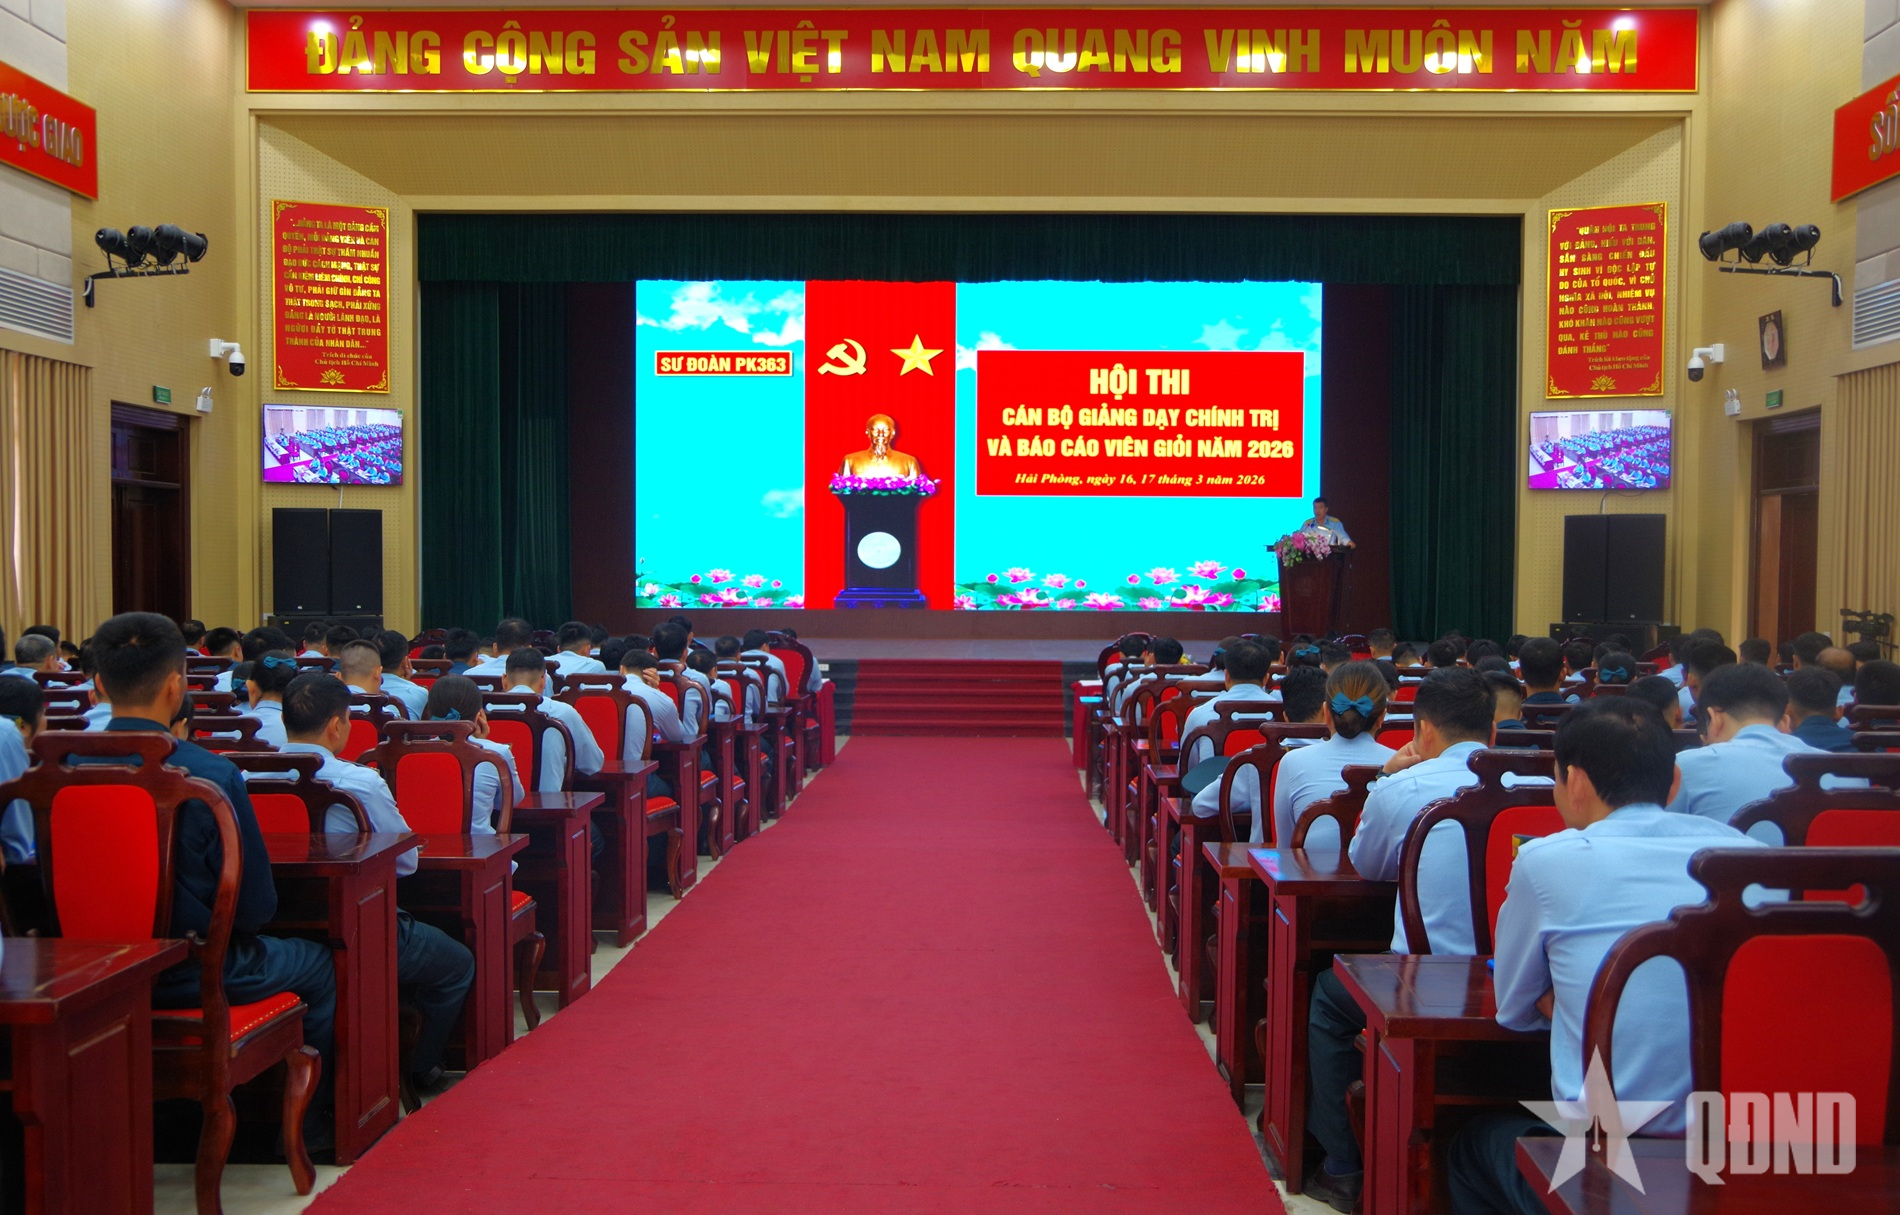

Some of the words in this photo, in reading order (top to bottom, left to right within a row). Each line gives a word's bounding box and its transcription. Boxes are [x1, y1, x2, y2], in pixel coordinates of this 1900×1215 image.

[305, 15, 441, 76] ĐẢNG
[463, 21, 596, 84] CỘNG
[618, 15, 722, 76] SẢN
[746, 21, 848, 83] VIỆT
[871, 29, 990, 74] NAM
[1012, 28, 1182, 79] QUANG
[1203, 29, 1321, 74] VINH
[1344, 19, 1492, 74] MUÔN
[1516, 19, 1638, 74] NĂM
[0, 92, 39, 152] ƯỢC
[43, 113, 83, 168] GIAO
[661, 356, 684, 372] SƯ
[686, 355, 730, 372] ĐOÀN
[736, 357, 786, 372] PK363
[1090, 363, 1137, 400] HỘI
[1146, 369, 1189, 395] THI
[1002, 405, 1042, 426] CÁN
[1048, 405, 1073, 429] BỘ
[1078, 403, 1137, 426] GIẢNG
[1143, 408, 1180, 430] DẠY
[1185, 406, 1243, 427] CHÍNH
[1250, 409, 1279, 431] TRỊ
[987, 436, 1012, 456] VÀ
[1017, 436, 1055, 456] BÁO
[1061, 436, 1099, 456] CÁO
[1105, 436, 1148, 457] VIÊN
[1153, 434, 1191, 457] GIỎI
[1197, 436, 1242, 458] NĂM
[1247, 440, 1294, 458] 2026
[1015, 473, 1038, 484] Hải
[1041, 473, 1083, 486] Phòng,
[1087, 474, 1116, 486] ngày
[1120, 474, 1137, 486] 16,
[1141, 474, 1155, 484] 17
[1158, 473, 1192, 487] tháng
[1196, 474, 1203, 485] 3
[1206, 474, 1233, 485] năm
[1236, 475, 1265, 485] 2026
